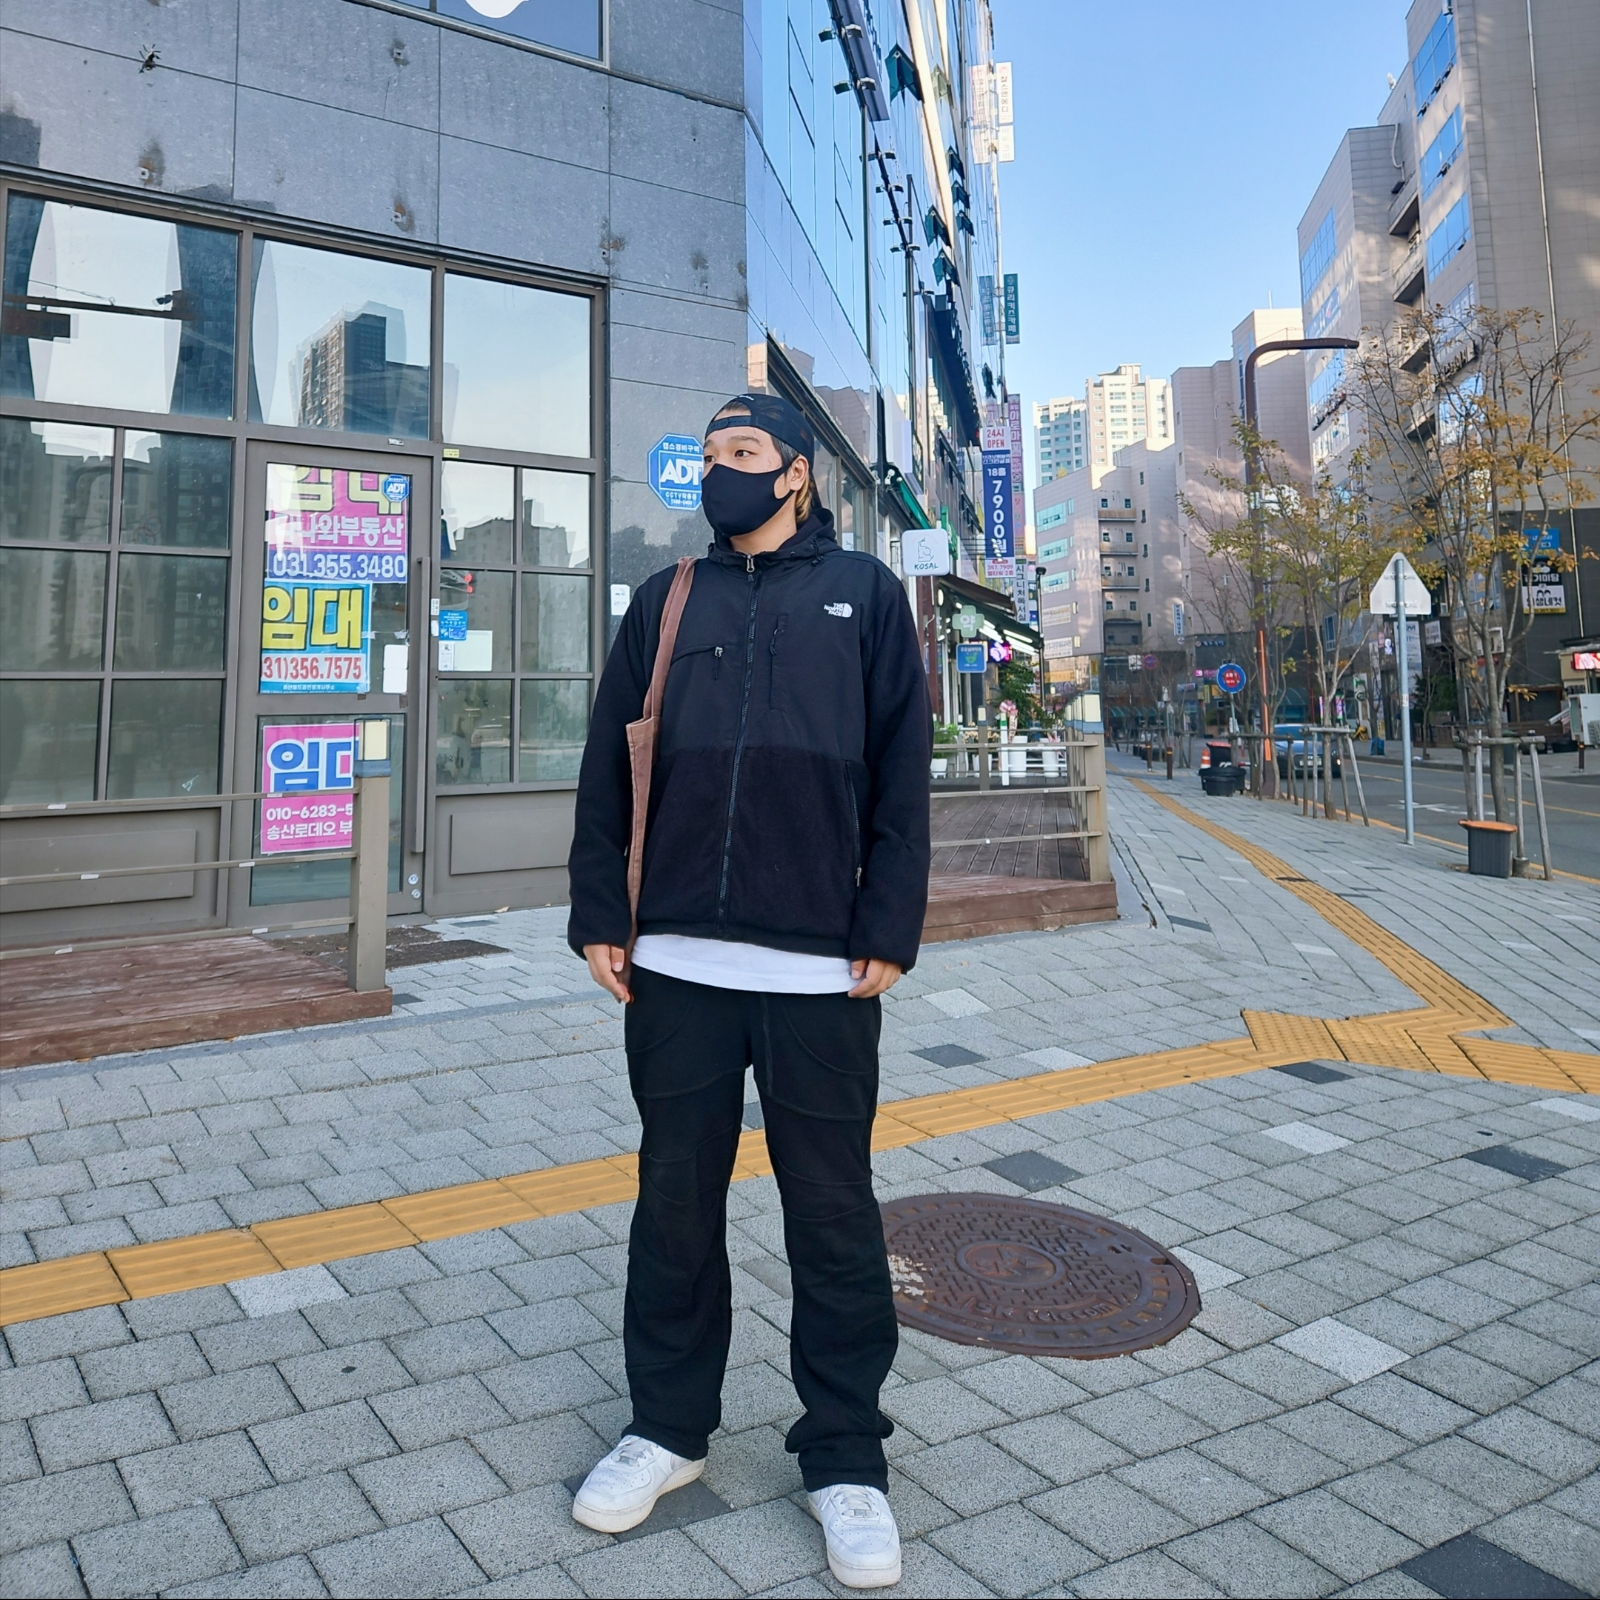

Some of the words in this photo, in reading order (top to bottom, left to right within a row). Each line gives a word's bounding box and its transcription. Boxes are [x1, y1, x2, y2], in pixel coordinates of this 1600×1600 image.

[986, 429, 1005, 438] 24시
[987, 440, 1005, 448] OPEN
[660, 458, 703, 486] ADT
[386, 482, 406, 494] ADT
[273, 552, 407, 578] 031.355.3480
[261, 586, 365, 651] 임대
[960, 615, 976, 631] 약
[267, 821, 337, 841] 송산로데오
[1026, 1302, 1114, 1322] telecom
